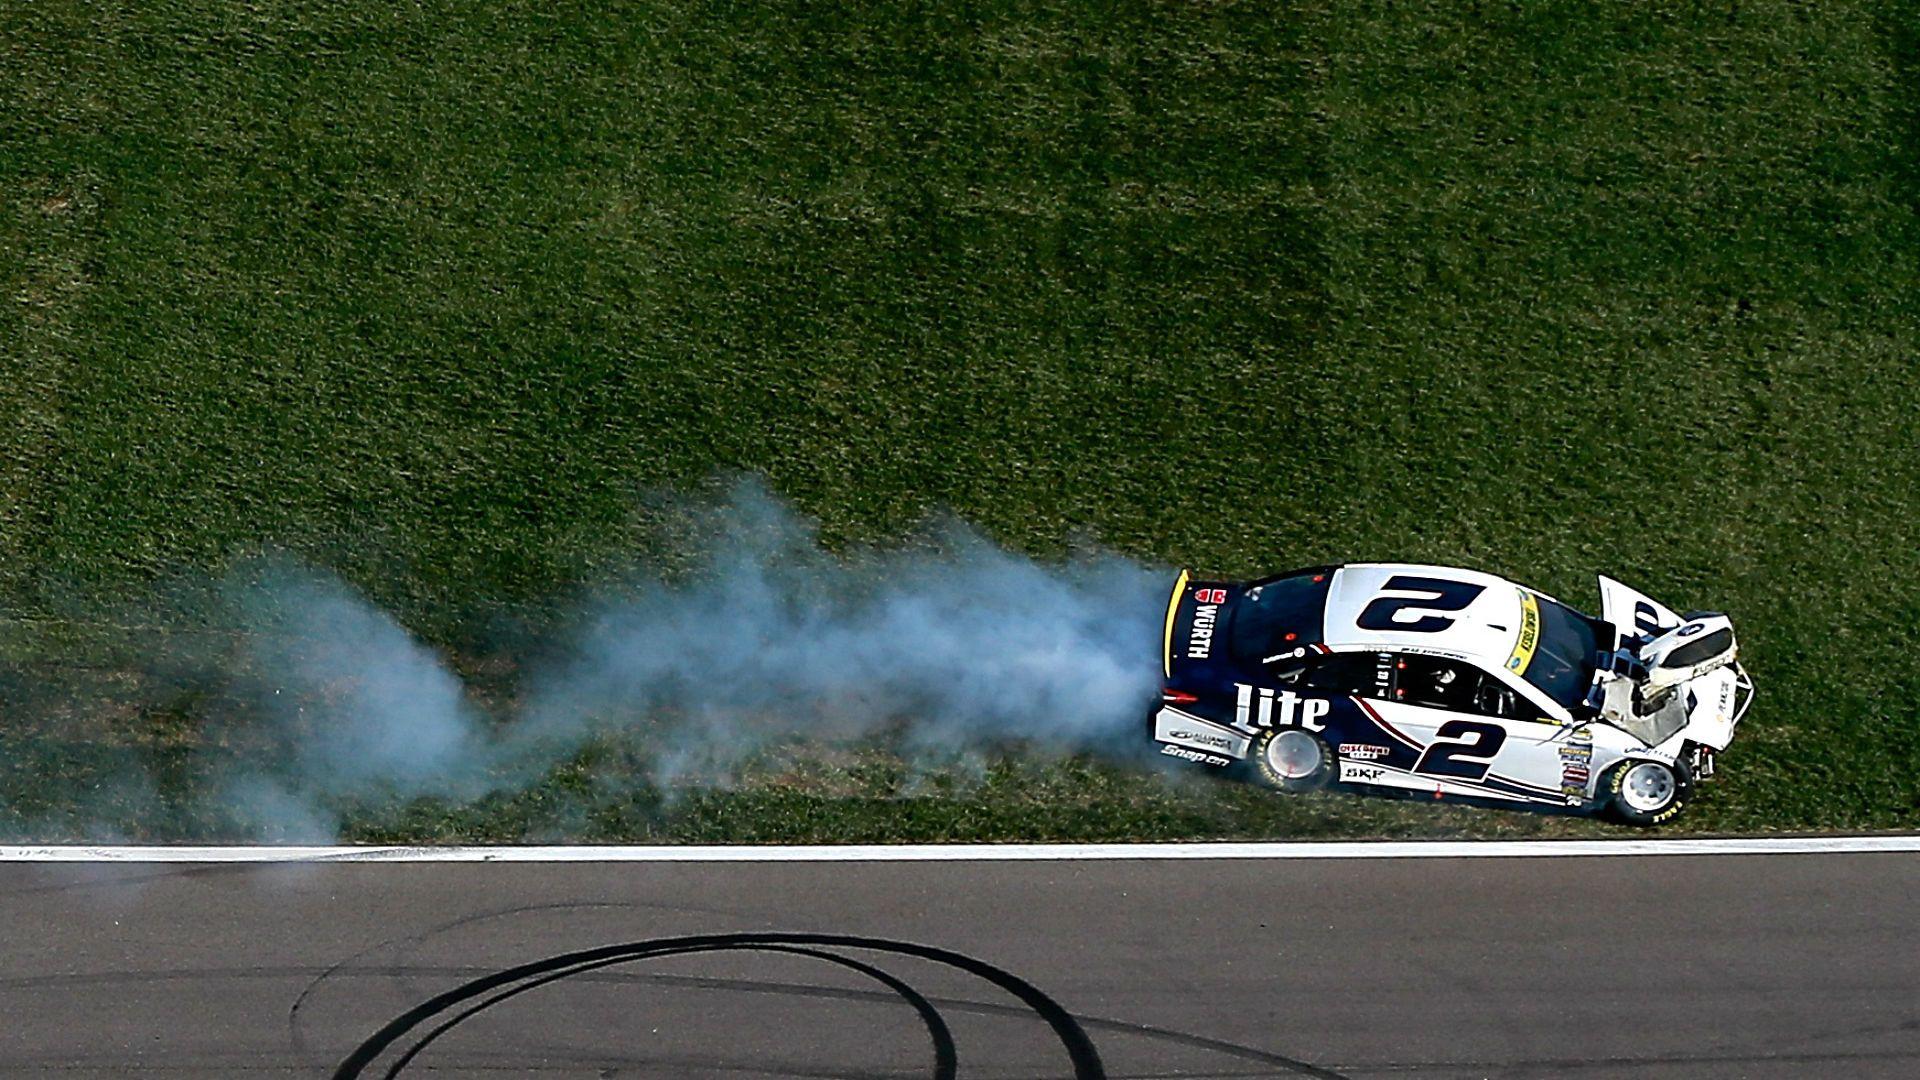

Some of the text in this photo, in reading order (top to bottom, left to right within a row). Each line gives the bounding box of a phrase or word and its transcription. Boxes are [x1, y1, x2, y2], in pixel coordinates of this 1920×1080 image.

[1356, 575, 1488, 633] 2
[1187, 605, 1218, 659] WÜRTH
[1230, 682, 1330, 733] lite
[1345, 768, 1386, 780] SKF
[1414, 719, 1507, 780] 2
[1653, 800, 1683, 822] EAGLE
